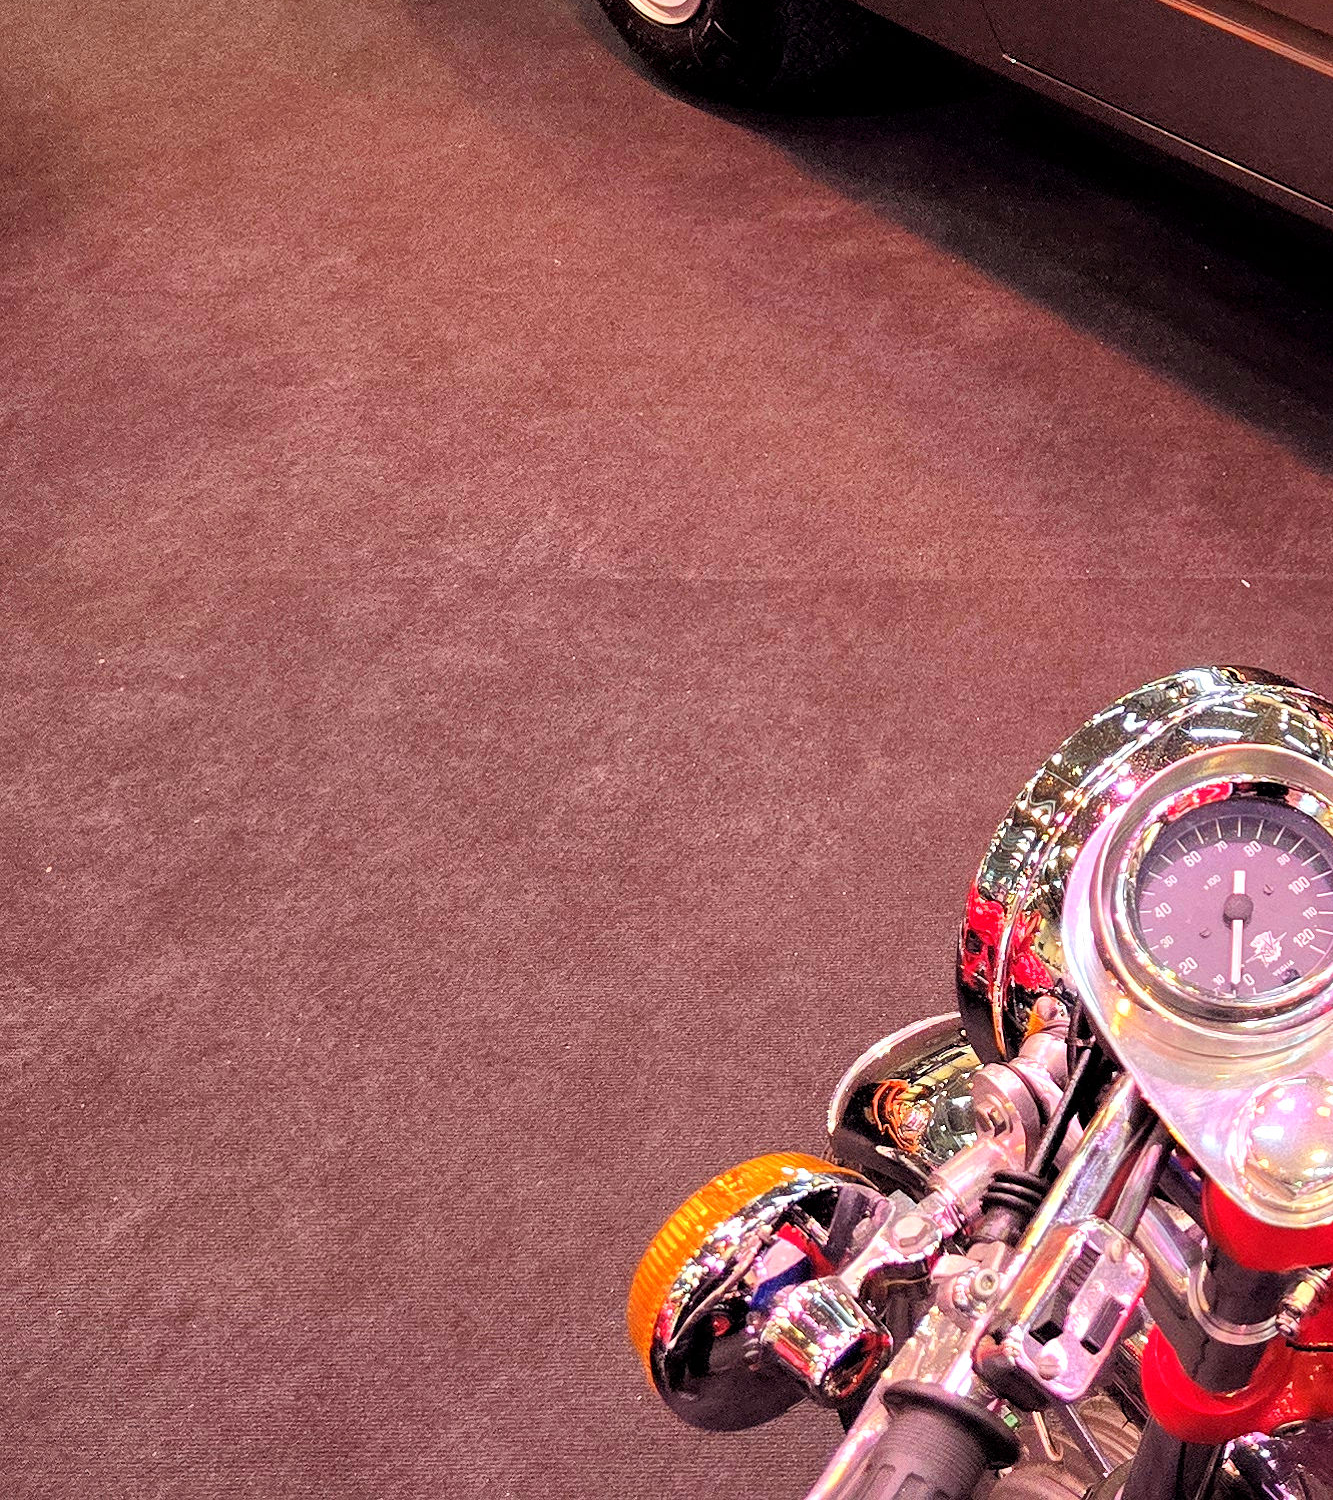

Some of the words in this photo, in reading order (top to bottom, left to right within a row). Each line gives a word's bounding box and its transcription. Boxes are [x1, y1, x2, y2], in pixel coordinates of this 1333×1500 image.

[1213, 840, 1229, 853] 70
[1243, 840, 1263, 858] 80
[1183, 850, 1203, 868] 60
[1276, 852, 1291, 867] 90
[1163, 874, 1178, 888] 50
[1287, 875, 1311, 895] 100
[1154, 901, 1173, 919] 40
[1302, 906, 1318, 920] 110
[1159, 934, 1175, 949] 30
[1293, 927, 1316, 949] 120
[1180, 956, 1199, 976] 20
[1212, 973, 1226, 986] 10
[1242, 973, 1256, 987] 0
